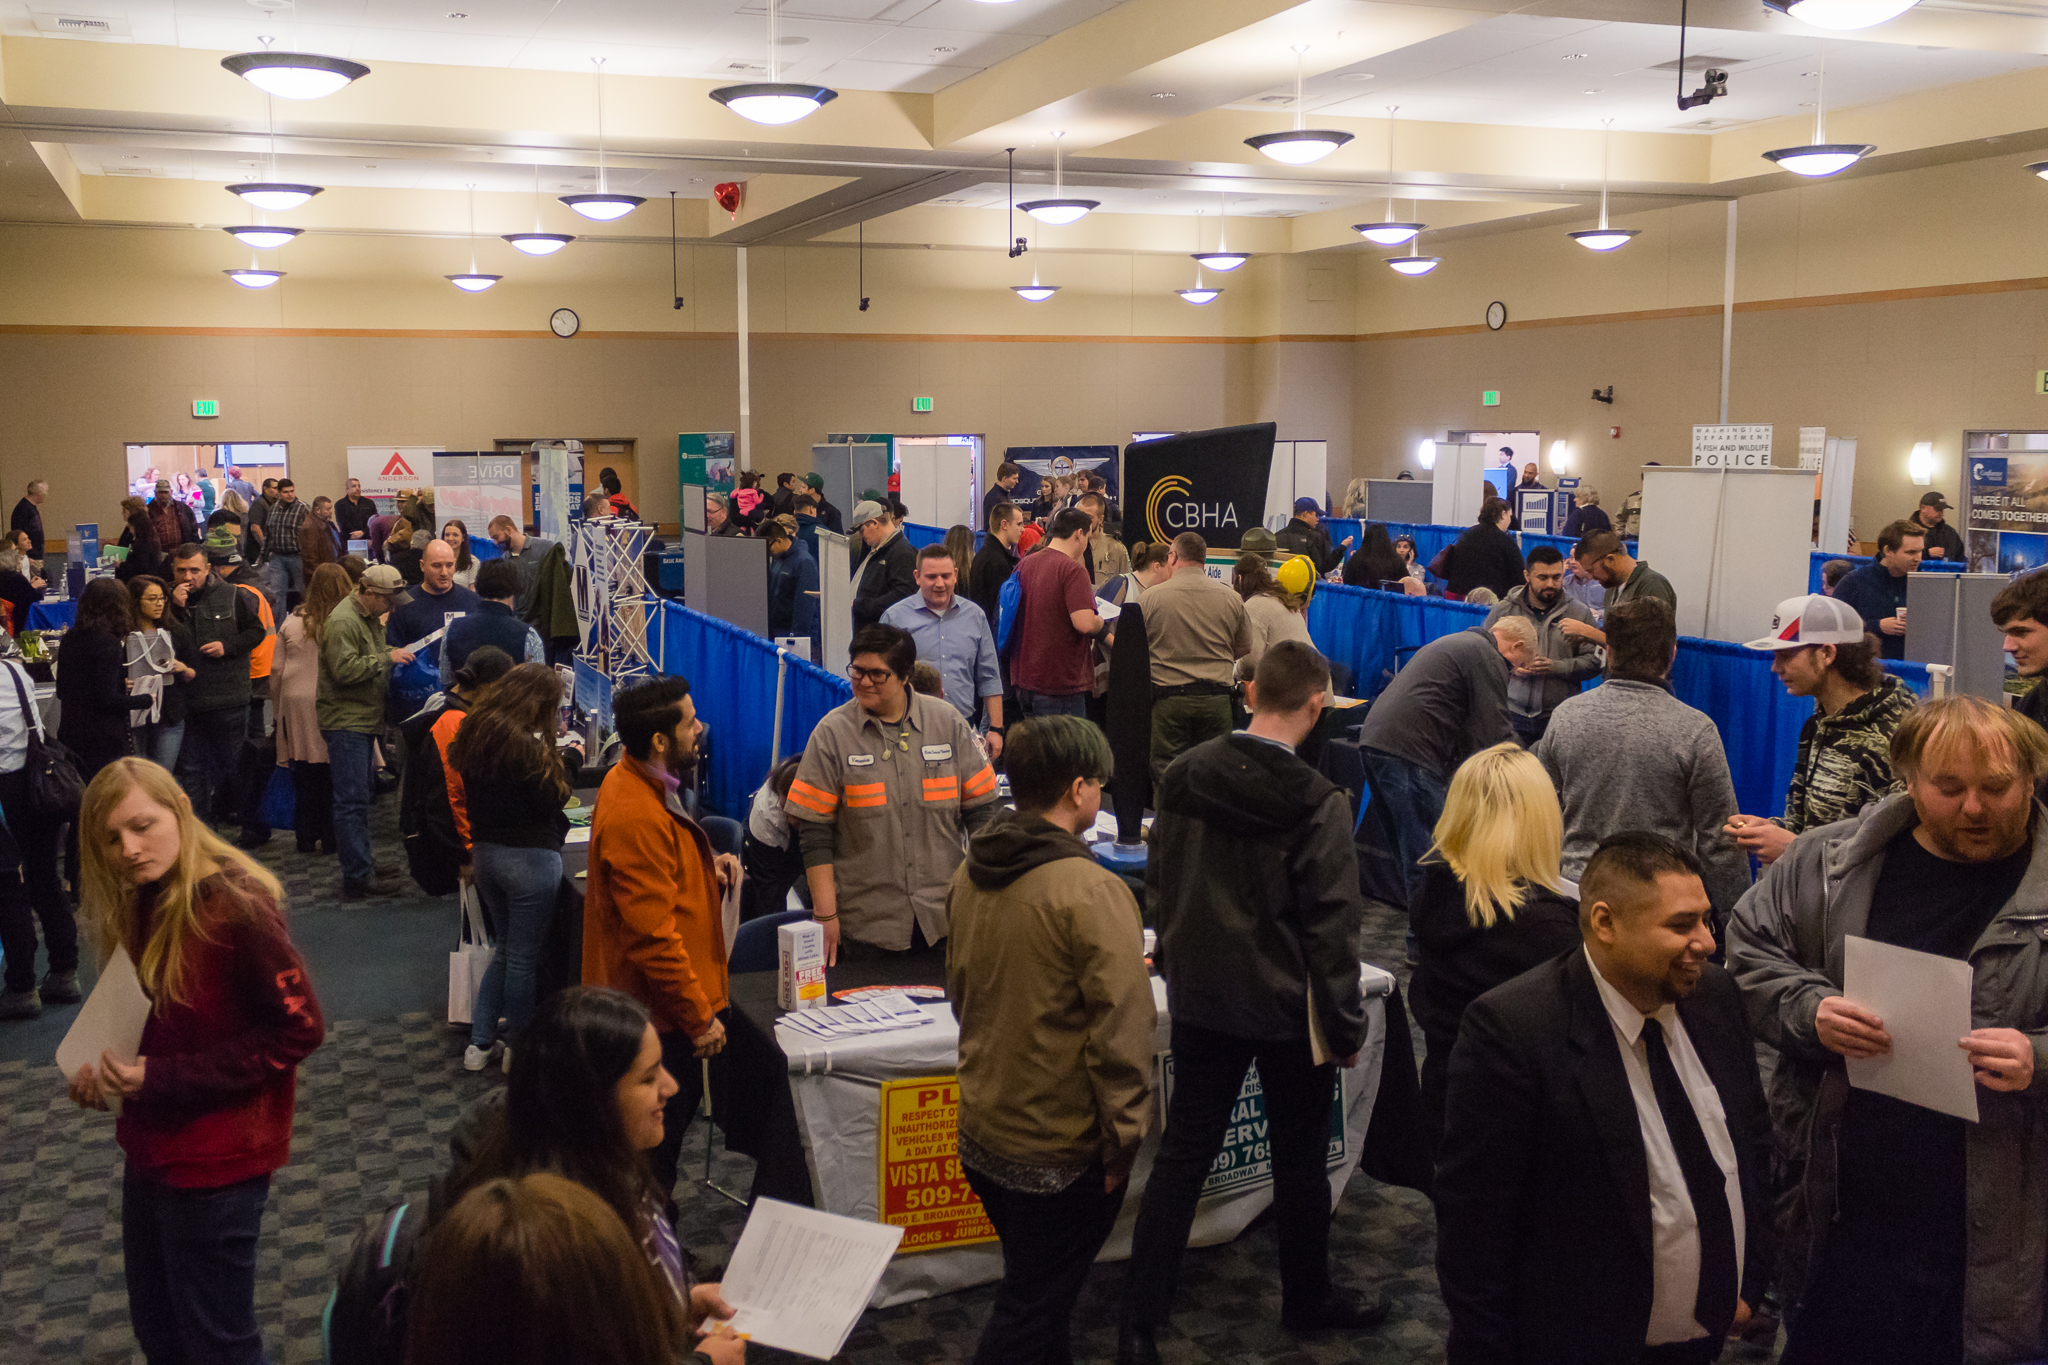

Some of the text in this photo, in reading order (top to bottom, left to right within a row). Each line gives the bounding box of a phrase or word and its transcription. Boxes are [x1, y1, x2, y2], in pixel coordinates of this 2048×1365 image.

[196, 401, 216, 415] EXIT
[916, 397, 931, 410] EXIT
[1695, 455, 1769, 466] POLICE
[1973, 496, 2026, 507] WHERE IT ALL
[1166, 502, 1238, 528] CBHA
[1972, 509, 2048, 522] COMES TOGETHER
[1207, 566, 1222, 579] Aide
[799, 966, 823, 980] FREE
[1245, 1071, 1257, 1082] 24
[1245, 1083, 1263, 1095] RIS
[918, 1089, 959, 1108] PL
[902, 1108, 945, 1122] RESPECT
[896, 1131, 958, 1146] VEHICLES WI
[1223, 1119, 1268, 1148] ERV
[905, 1148, 912, 1157] A
[914, 1146, 933, 1156] DAY
[936, 1144, 948, 1153] AT
[889, 1159, 966, 1188] VISTA SE
[1208, 1165, 1259, 1186] BROADWAY
[906, 1183, 981, 1209] 509-7
[923, 1206, 978, 1221] BROADWAY
[901, 1230, 942, 1245] LOCKS
